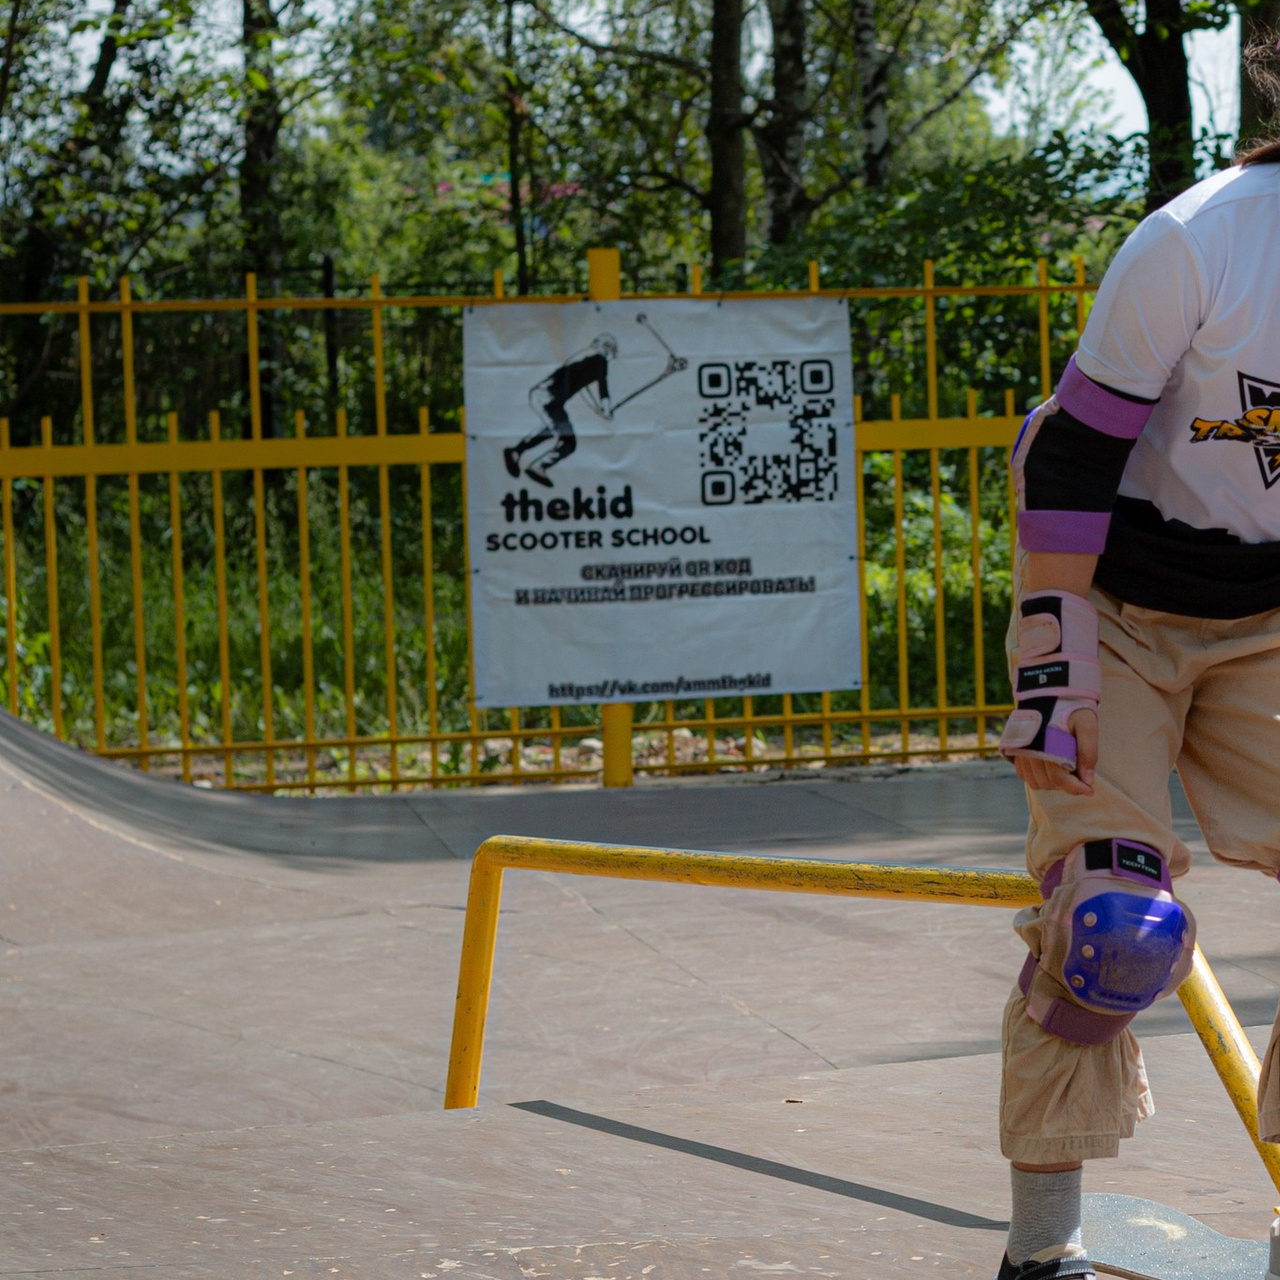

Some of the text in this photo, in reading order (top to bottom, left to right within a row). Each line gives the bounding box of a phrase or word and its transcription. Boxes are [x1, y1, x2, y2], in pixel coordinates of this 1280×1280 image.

[501, 485, 634, 522] thekid
[486, 526, 711, 552] SCOOTER SCHOOL
